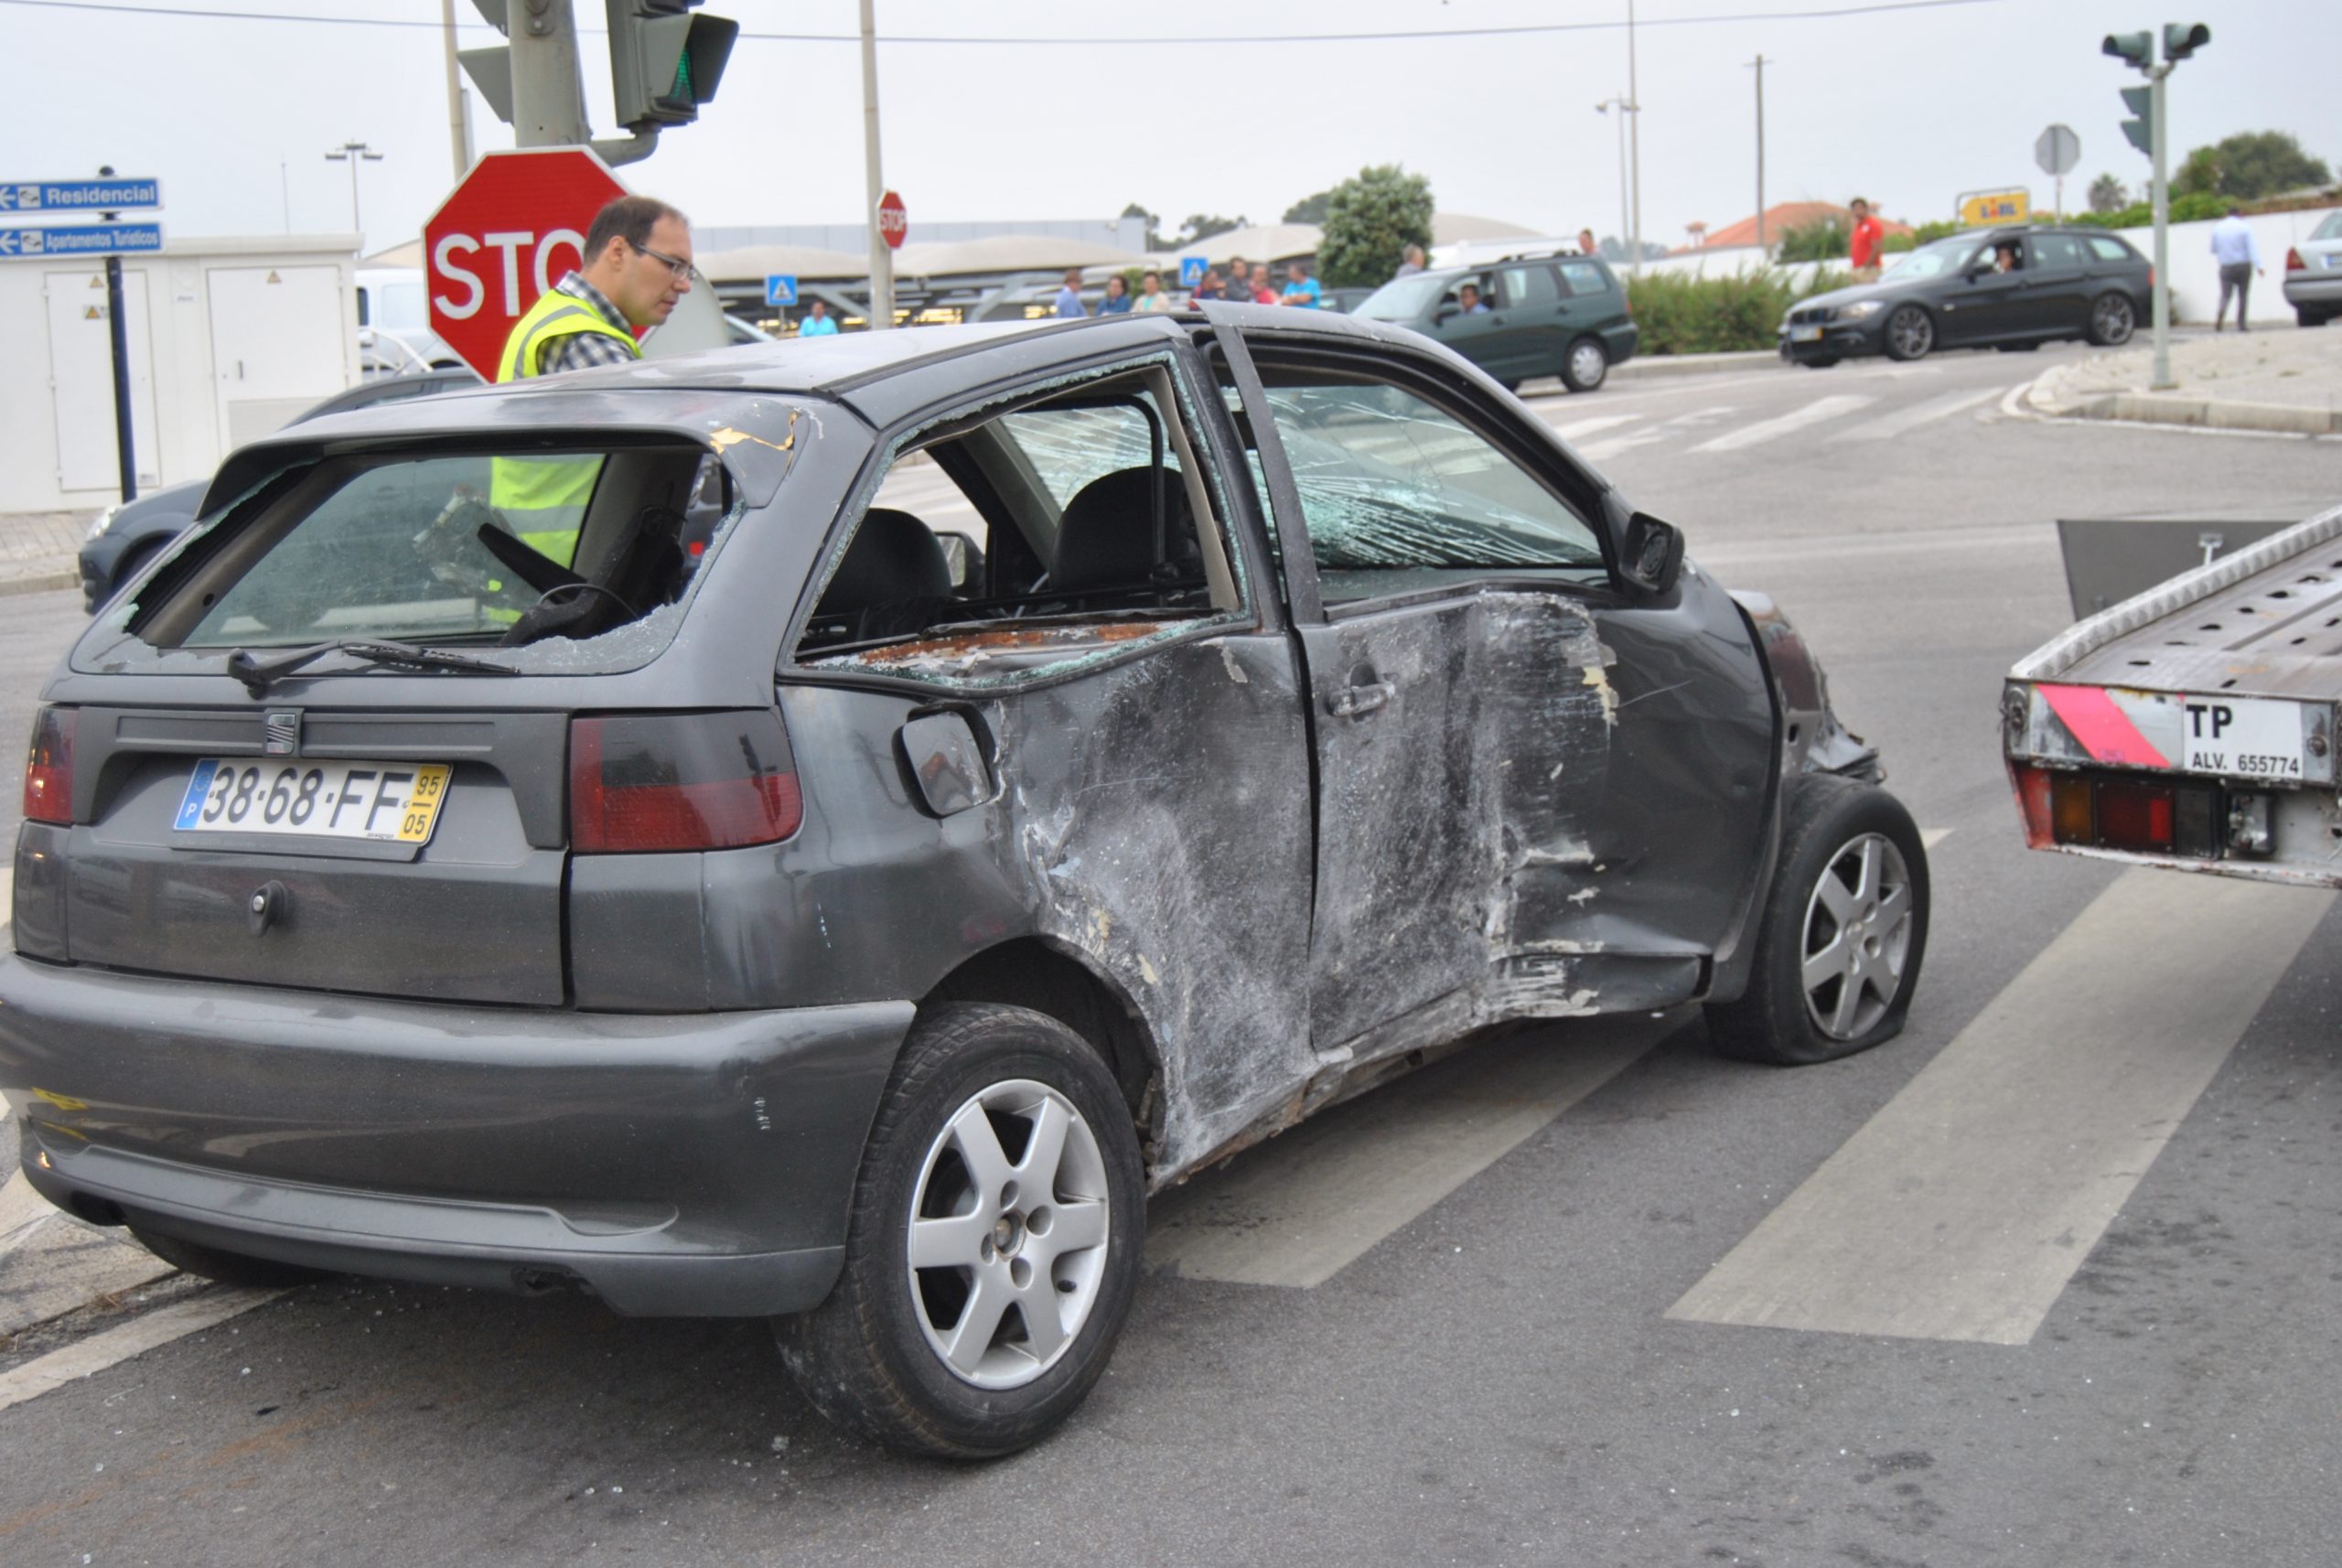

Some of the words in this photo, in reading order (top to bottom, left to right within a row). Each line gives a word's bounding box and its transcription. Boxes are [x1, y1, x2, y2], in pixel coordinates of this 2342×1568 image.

[48, 186, 156, 205] Residencial
[879, 209, 907, 231] STOP
[47, 231, 112, 252] Apartamentos
[434, 229, 586, 320] STO
[2186, 703, 2232, 739] TP
[2192, 752, 2228, 770] ALV.
[2238, 754, 2300, 774] 655774
[416, 776, 441, 796] 95
[185, 802, 198, 818] P
[403, 813, 427, 834] 05
